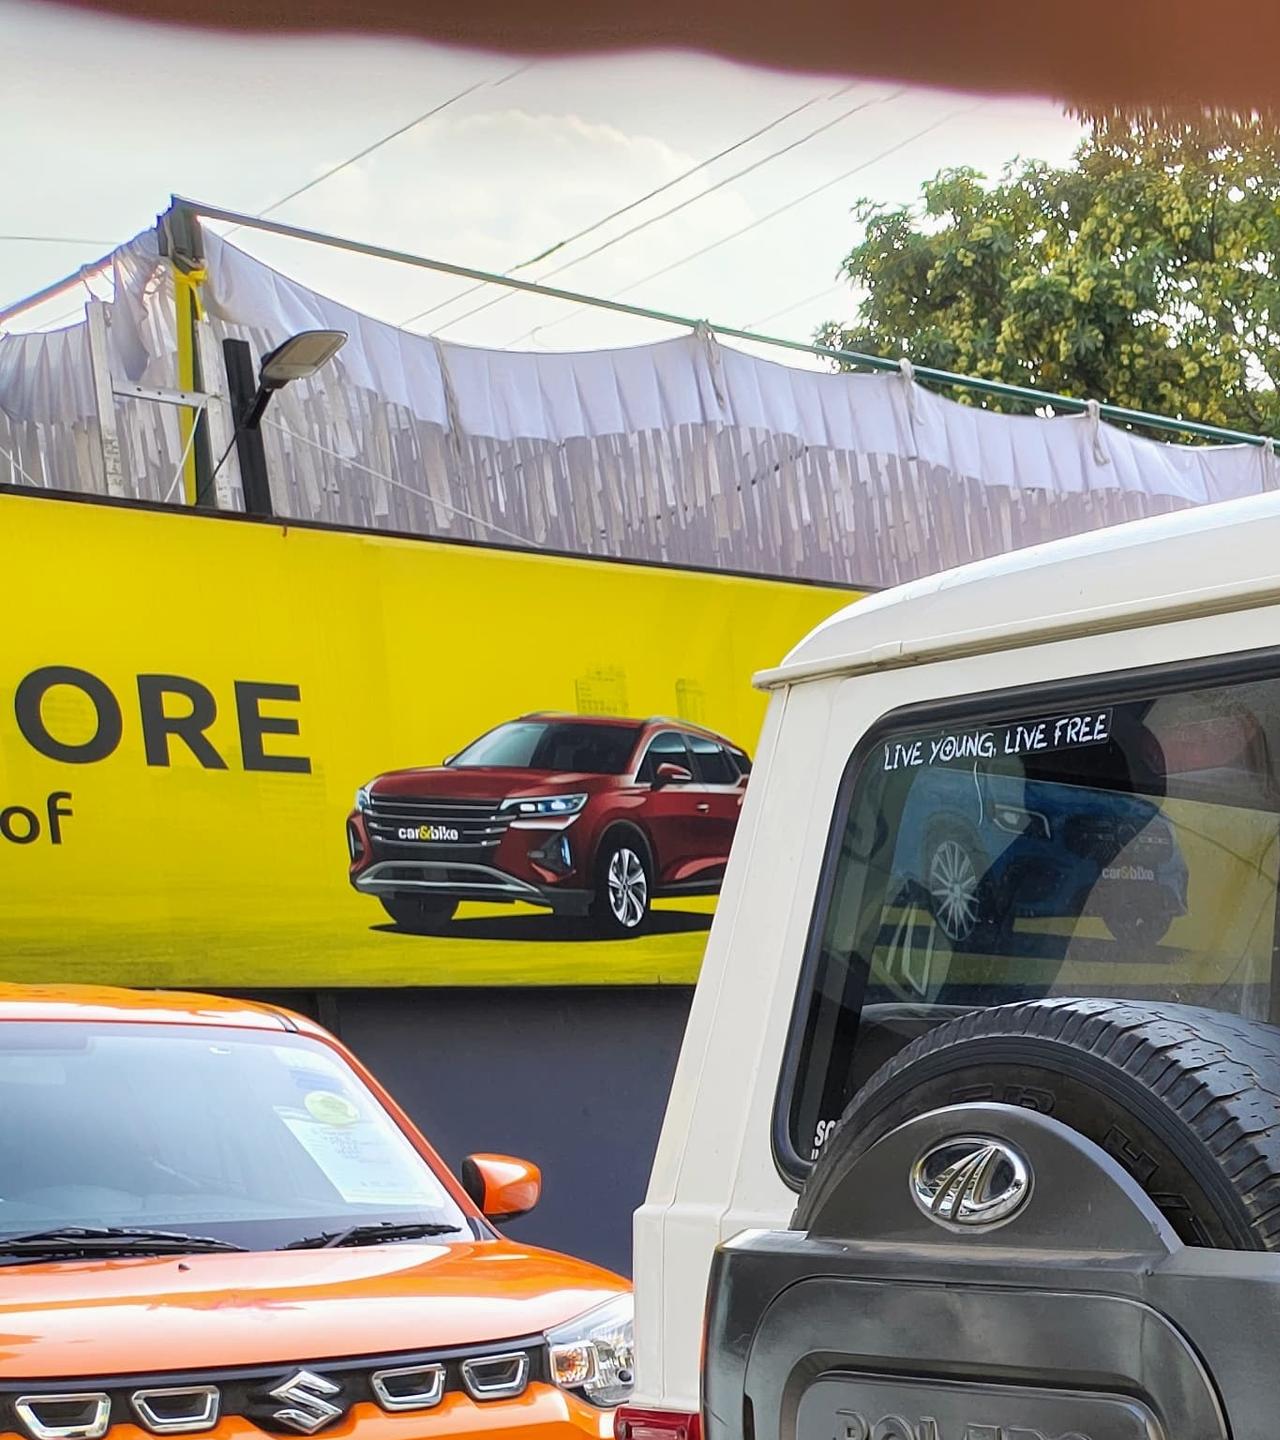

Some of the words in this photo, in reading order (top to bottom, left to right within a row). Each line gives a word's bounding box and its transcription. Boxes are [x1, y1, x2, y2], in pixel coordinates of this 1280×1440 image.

[14, 665, 312, 774] ORE
[883, 740, 924, 771] LIVE
[1004, 723, 1049, 755] LIVE
[1054, 713, 1109, 746] FREE
[0, 791, 73, 845] of
